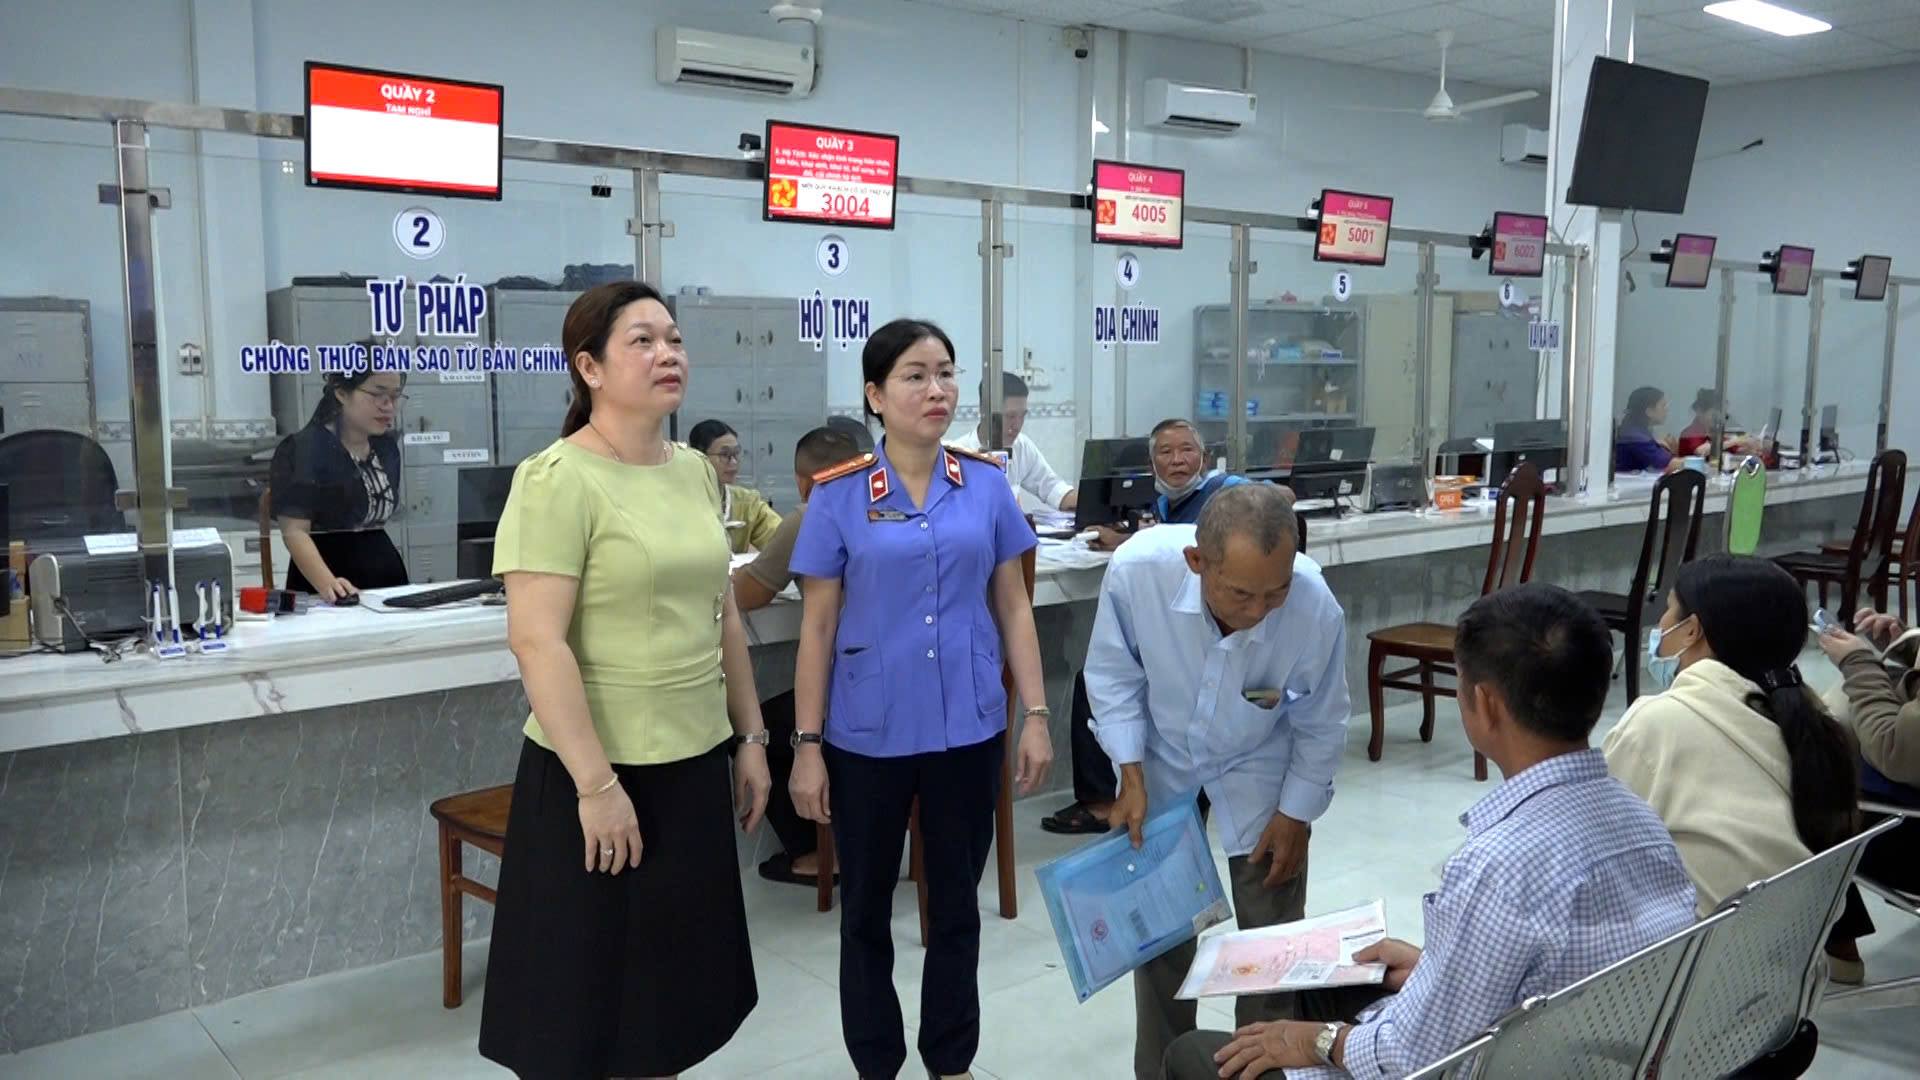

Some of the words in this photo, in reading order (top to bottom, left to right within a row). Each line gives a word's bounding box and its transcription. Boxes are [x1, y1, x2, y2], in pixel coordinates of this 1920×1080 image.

[381, 82, 422, 102] QUẦY
[426, 89, 436, 104] 2
[847, 140, 854, 152] 3
[821, 192, 870, 216] 3004
[1131, 204, 1167, 224] 4005
[412, 216, 431, 248] 2
[1347, 227, 1375, 244] 5001
[827, 242, 840, 269] 3
[1124, 259, 1133, 281] 4
[1338, 275, 1346, 295] 5
[1504, 282, 1511, 300] 6
[369, 278, 405, 333] TƯ
[418, 274, 486, 333] PHÁP
[800, 289, 824, 348] HỘ
[831, 298, 869, 348] TỊCH
[1095, 306, 1117, 349] ĐỊA
[1121, 300, 1159, 342] CHÍNH
[241, 339, 310, 372] CHỨNG
[317, 344, 367, 377] THỰC
[371, 338, 411, 371] BẢN
[416, 348, 450, 372] SAO
[456, 342, 479, 371] TỪ
[482, 340, 516, 371] BẢN
